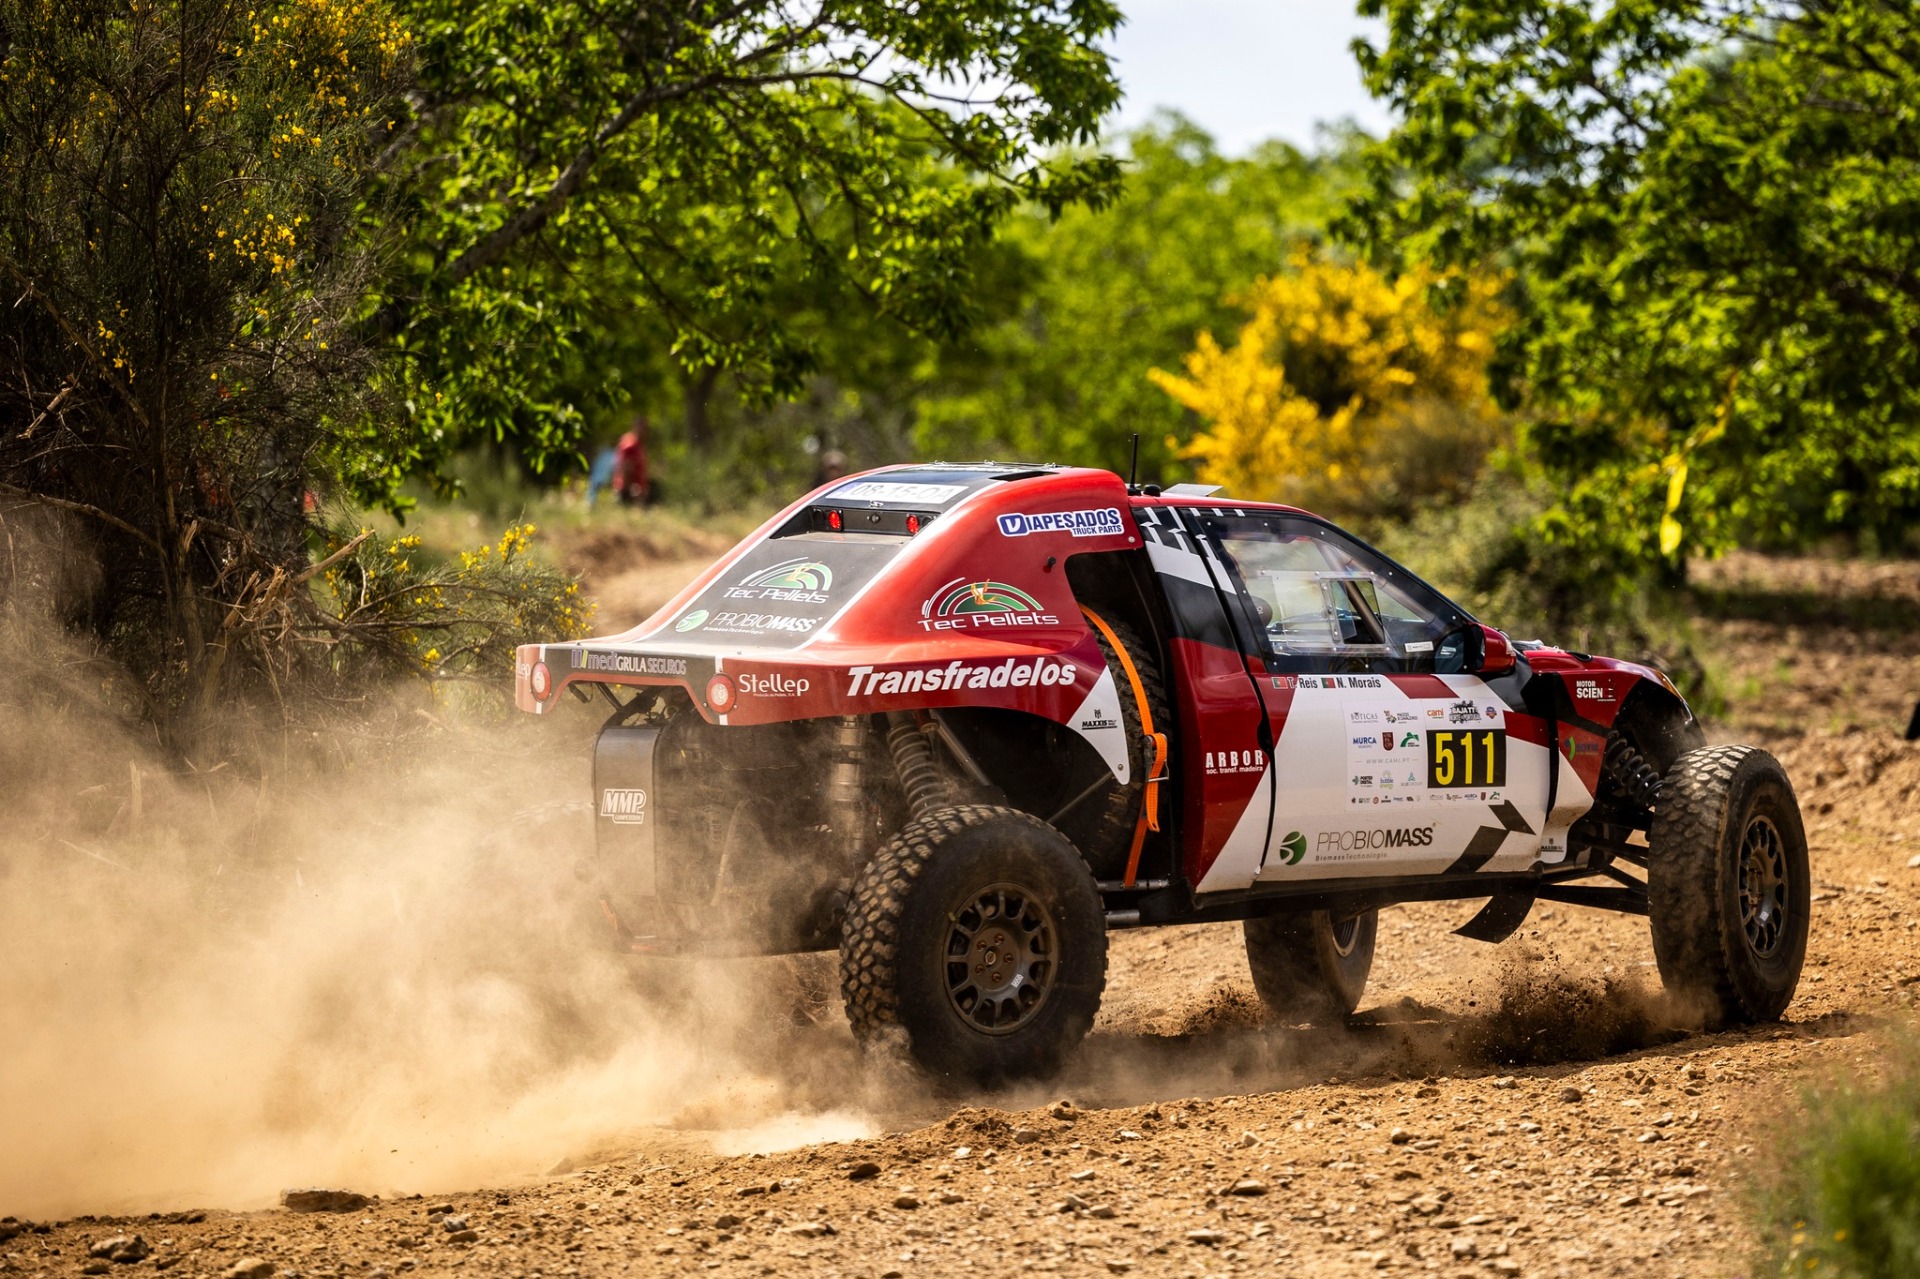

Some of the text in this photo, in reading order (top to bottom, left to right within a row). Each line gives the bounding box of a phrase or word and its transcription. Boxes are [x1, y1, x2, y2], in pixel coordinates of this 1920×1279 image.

[1000, 510, 1120, 535] VIAPESADOS
[1073, 525, 1122, 536] TRUCK PARTS
[723, 587, 830, 604] Tec Pellets
[709, 612, 817, 633] PROBIOMASS
[918, 612, 1060, 632] Tec Pellets
[739, 673, 810, 697] Stellep
[847, 657, 1077, 697] Transfradelos
[1300, 677, 1319, 689] Reis
[1336, 677, 1382, 689] N. Morais
[1205, 750, 1264, 768] ARBOR
[1435, 732, 1495, 786] 511
[604, 792, 644, 814] MMP
[1317, 827, 1434, 852] PROBIOMASS
